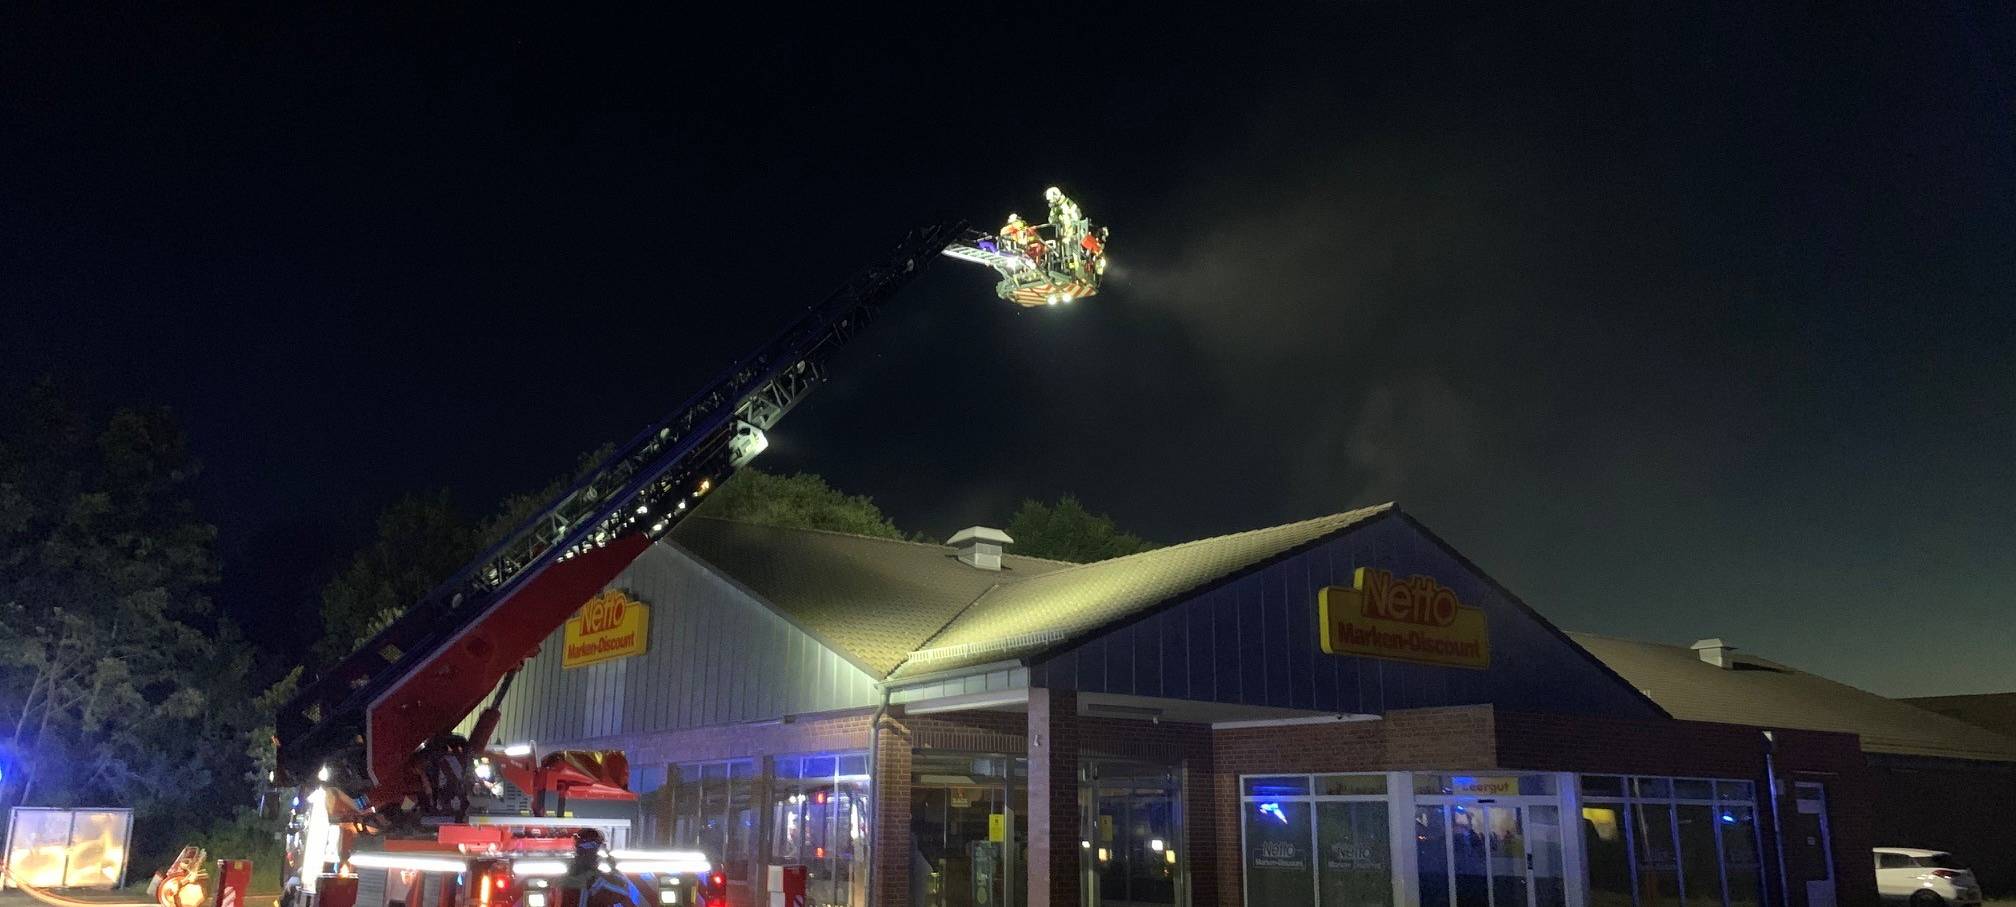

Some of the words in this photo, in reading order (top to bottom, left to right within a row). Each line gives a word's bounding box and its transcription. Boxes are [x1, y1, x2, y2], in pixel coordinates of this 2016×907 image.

[579, 590, 626, 636] Netto
[1362, 567, 1458, 627] Netto
[567, 631, 635, 659] Marken-Discount
[1337, 622, 1481, 658] Marken-Discount
